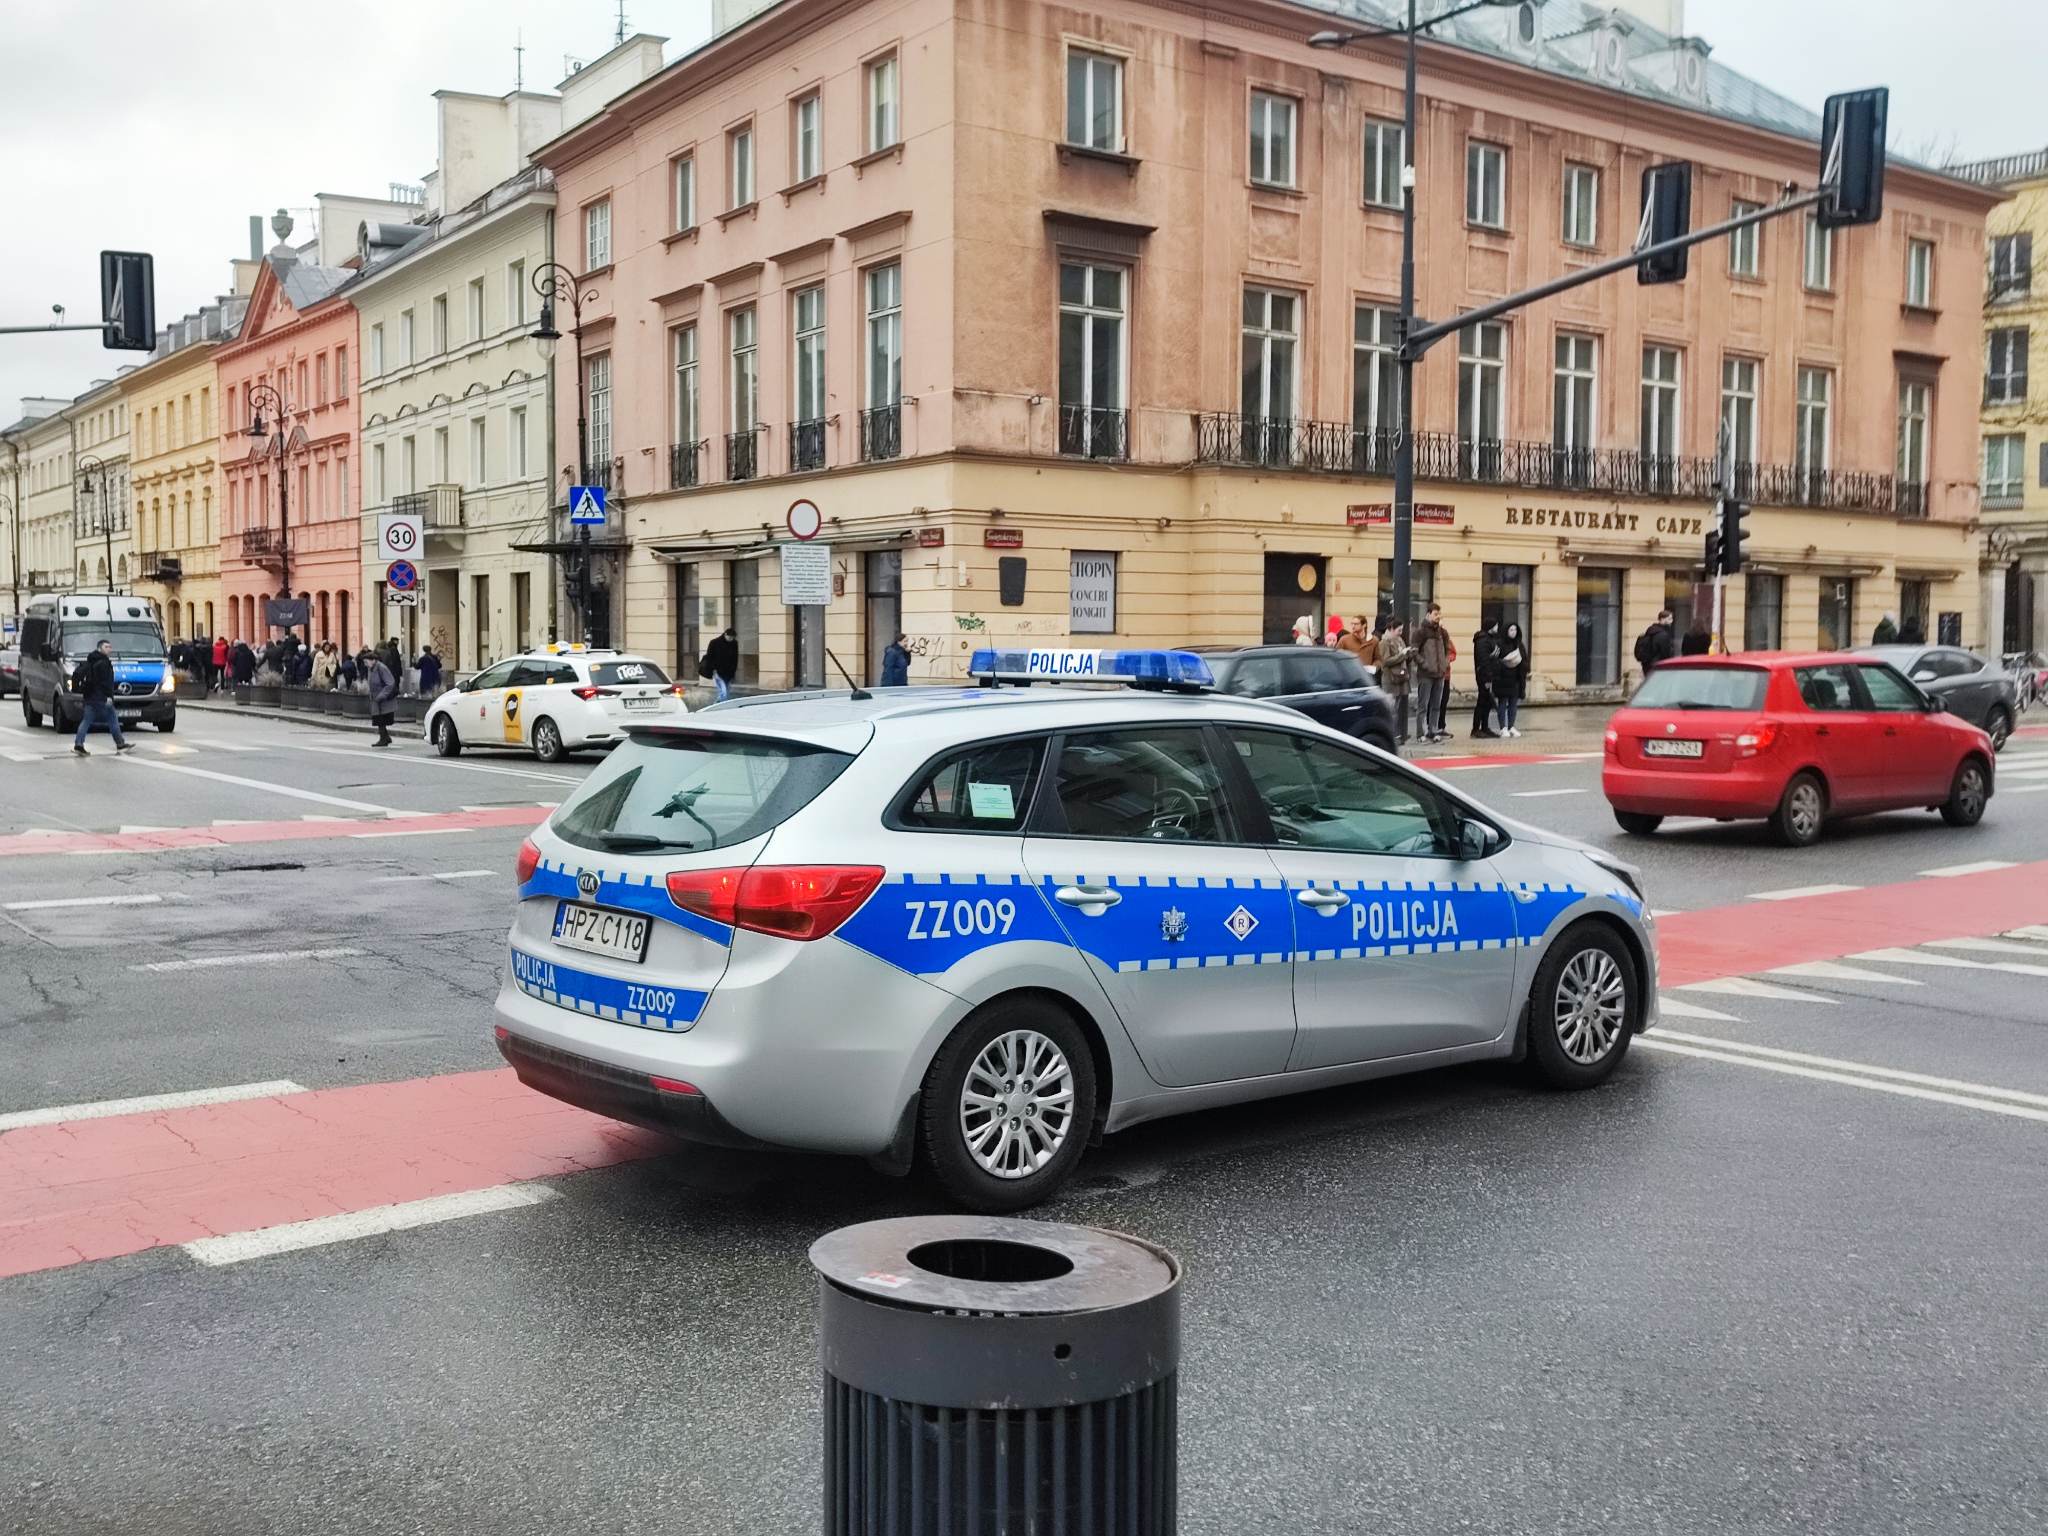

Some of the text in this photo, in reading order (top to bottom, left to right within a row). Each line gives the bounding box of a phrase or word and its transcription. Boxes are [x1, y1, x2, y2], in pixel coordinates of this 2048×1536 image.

[1505, 506, 1703, 536] RESTAURANT CAFE
[391, 529, 412, 545] 30
[1070, 561, 1112, 578] CHOPIN
[1072, 606, 1107, 618] TONIGHT
[1029, 652, 1094, 675] POLICJA
[579, 875, 598, 892] KIA
[562, 907, 600, 942] HPZ
[601, 915, 645, 951] C118
[905, 898, 1016, 940] ZZ009
[1351, 899, 1459, 941] POLICJA
[516, 952, 557, 990] POLICJA
[627, 985, 676, 1015] ZZ009
